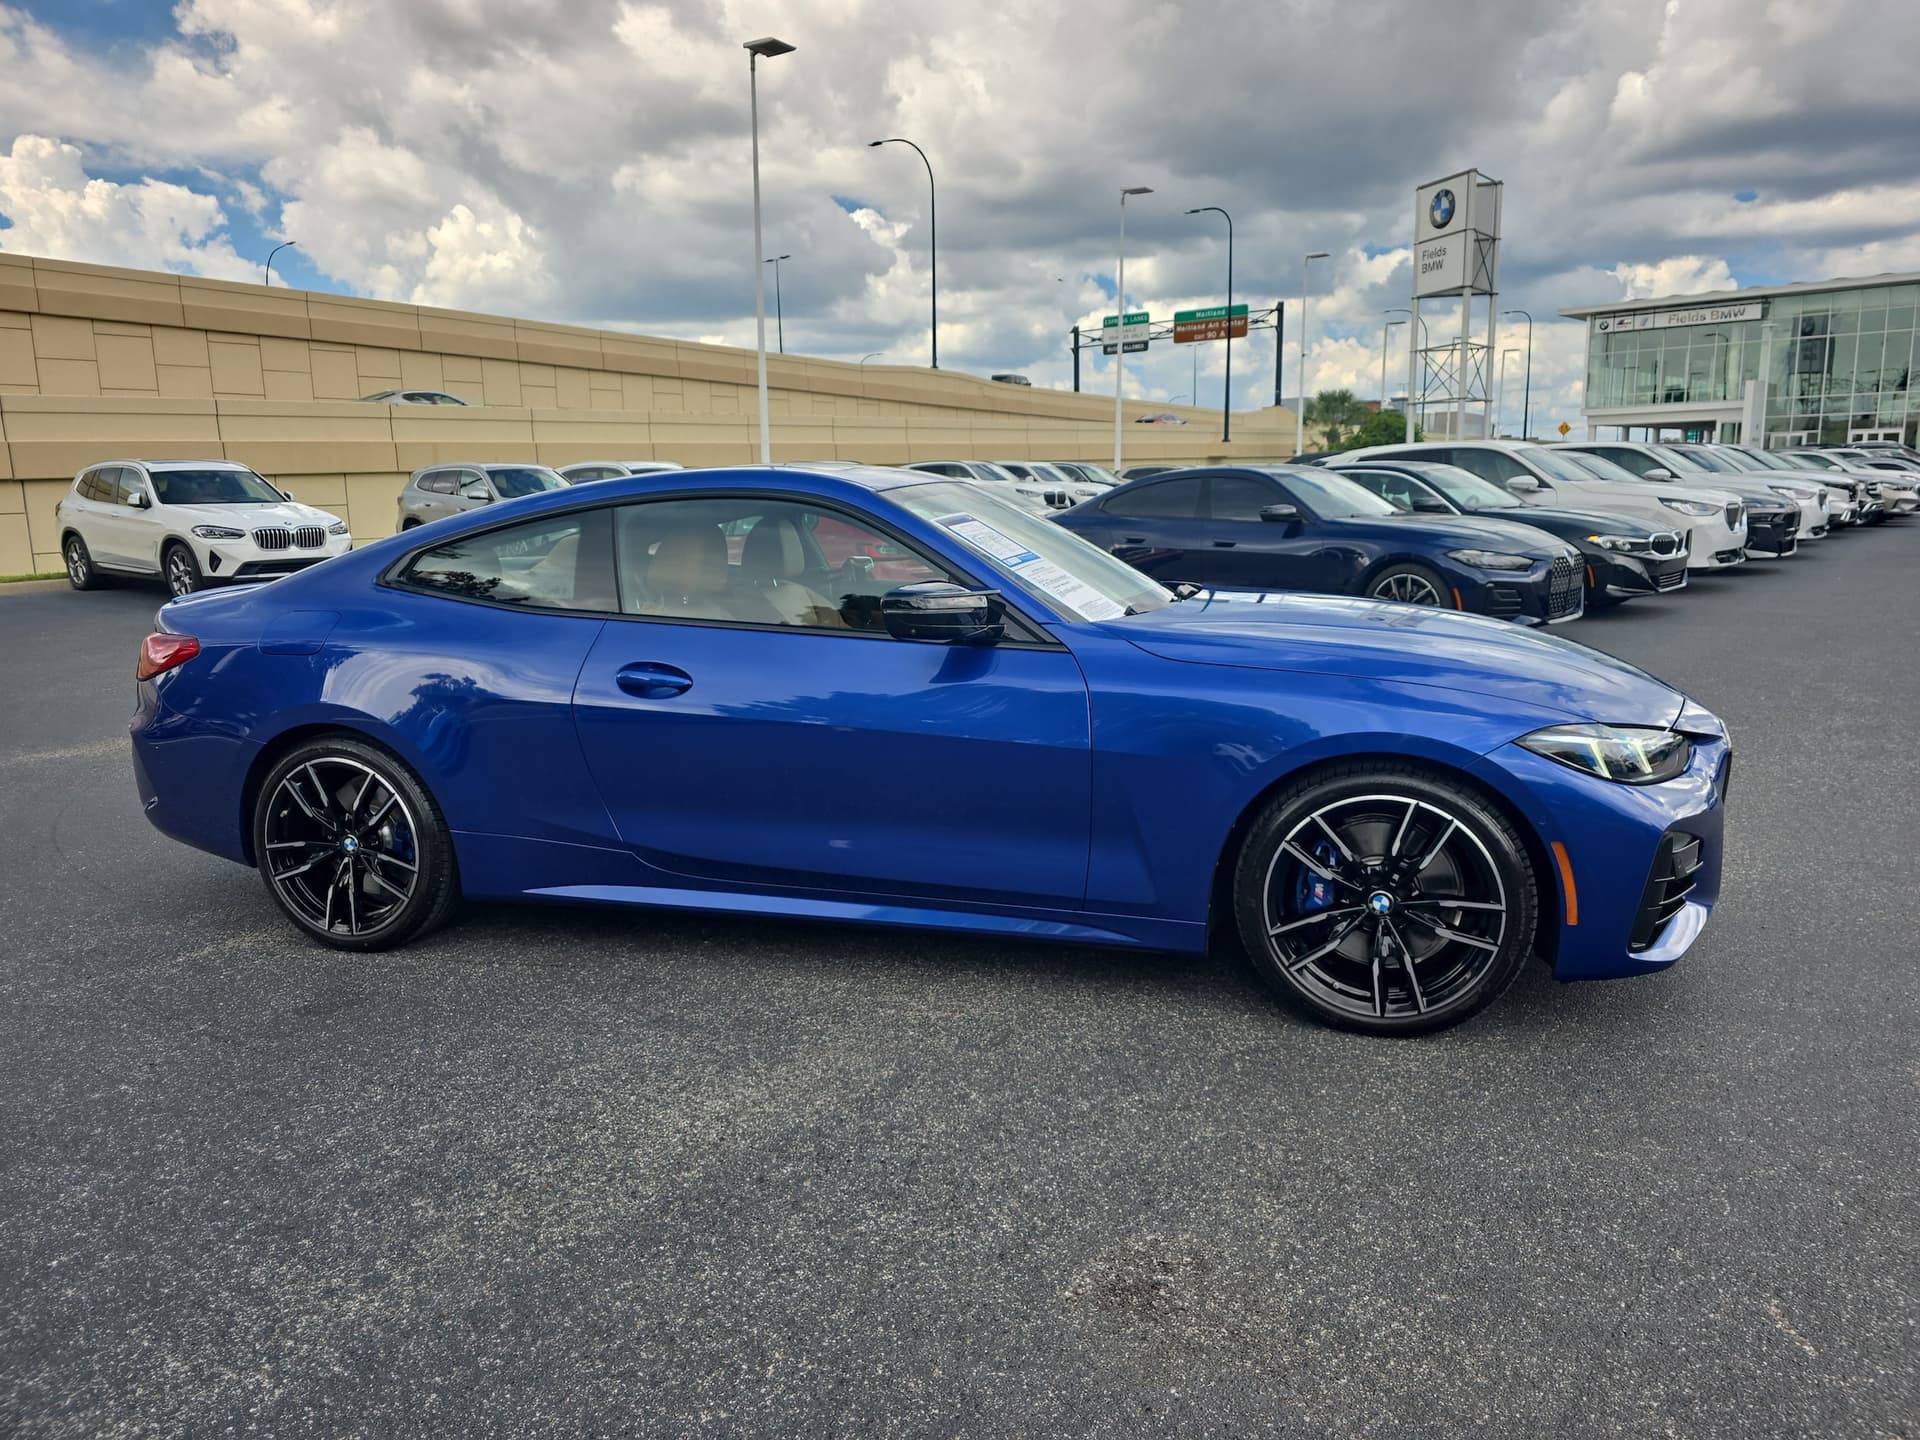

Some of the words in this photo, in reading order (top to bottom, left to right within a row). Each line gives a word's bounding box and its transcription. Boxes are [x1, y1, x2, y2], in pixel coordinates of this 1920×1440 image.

[1422, 246, 1447, 260] Fields
[1421, 259, 1444, 274] BMW
[1195, 308, 1226, 318] Maitland
[1668, 311, 1707, 324] Fields
[1710, 306, 1746, 320] BMW
[1176, 322, 1206, 332] Maitland
